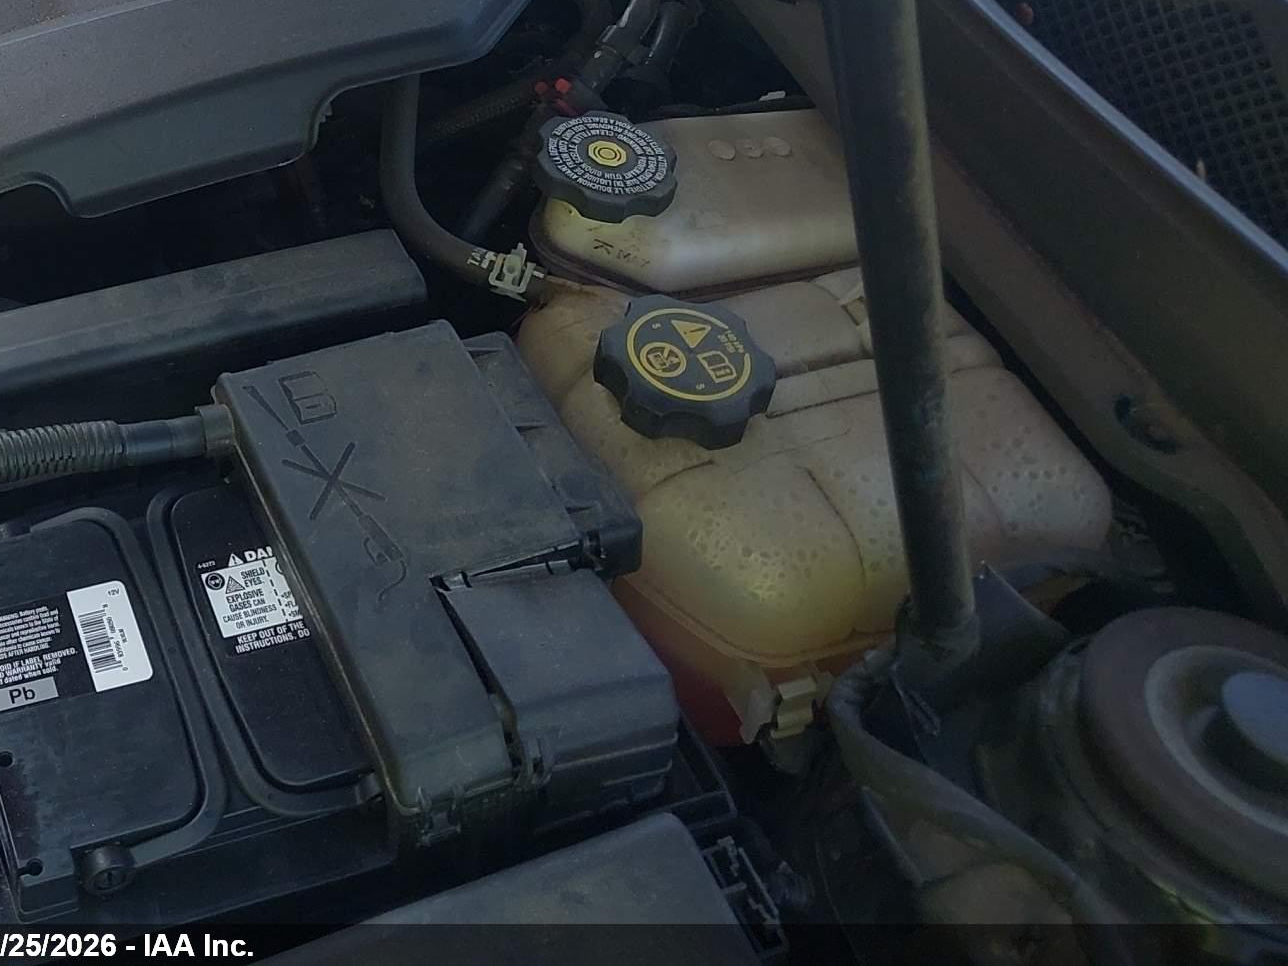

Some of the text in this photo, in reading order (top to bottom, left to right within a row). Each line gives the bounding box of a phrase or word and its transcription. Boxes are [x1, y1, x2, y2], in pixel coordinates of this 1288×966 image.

[241, 567, 265, 579] SHIELD
[244, 577, 265, 588] EYES.
[226, 588, 264, 604] EXPLOSIVE
[229, 598, 266, 612] GASES CAN
[222, 612, 243, 623] CAUSE
[243, 604, 277, 618] BLINDNESS
[236, 621, 245, 629] OR
[237, 621, 304, 644] KEEP OUT OF THE
[235, 628, 310, 653] INSTRUCTIONS. DO
[5, 661, 42, 676] WARRANTY
[44, 658, 61, 667] valid
[21, 656, 40, 666] LABEL
[4, 674, 22, 683] dated
[23, 670, 41, 679] when
[8, 687, 35, 704] Pb
